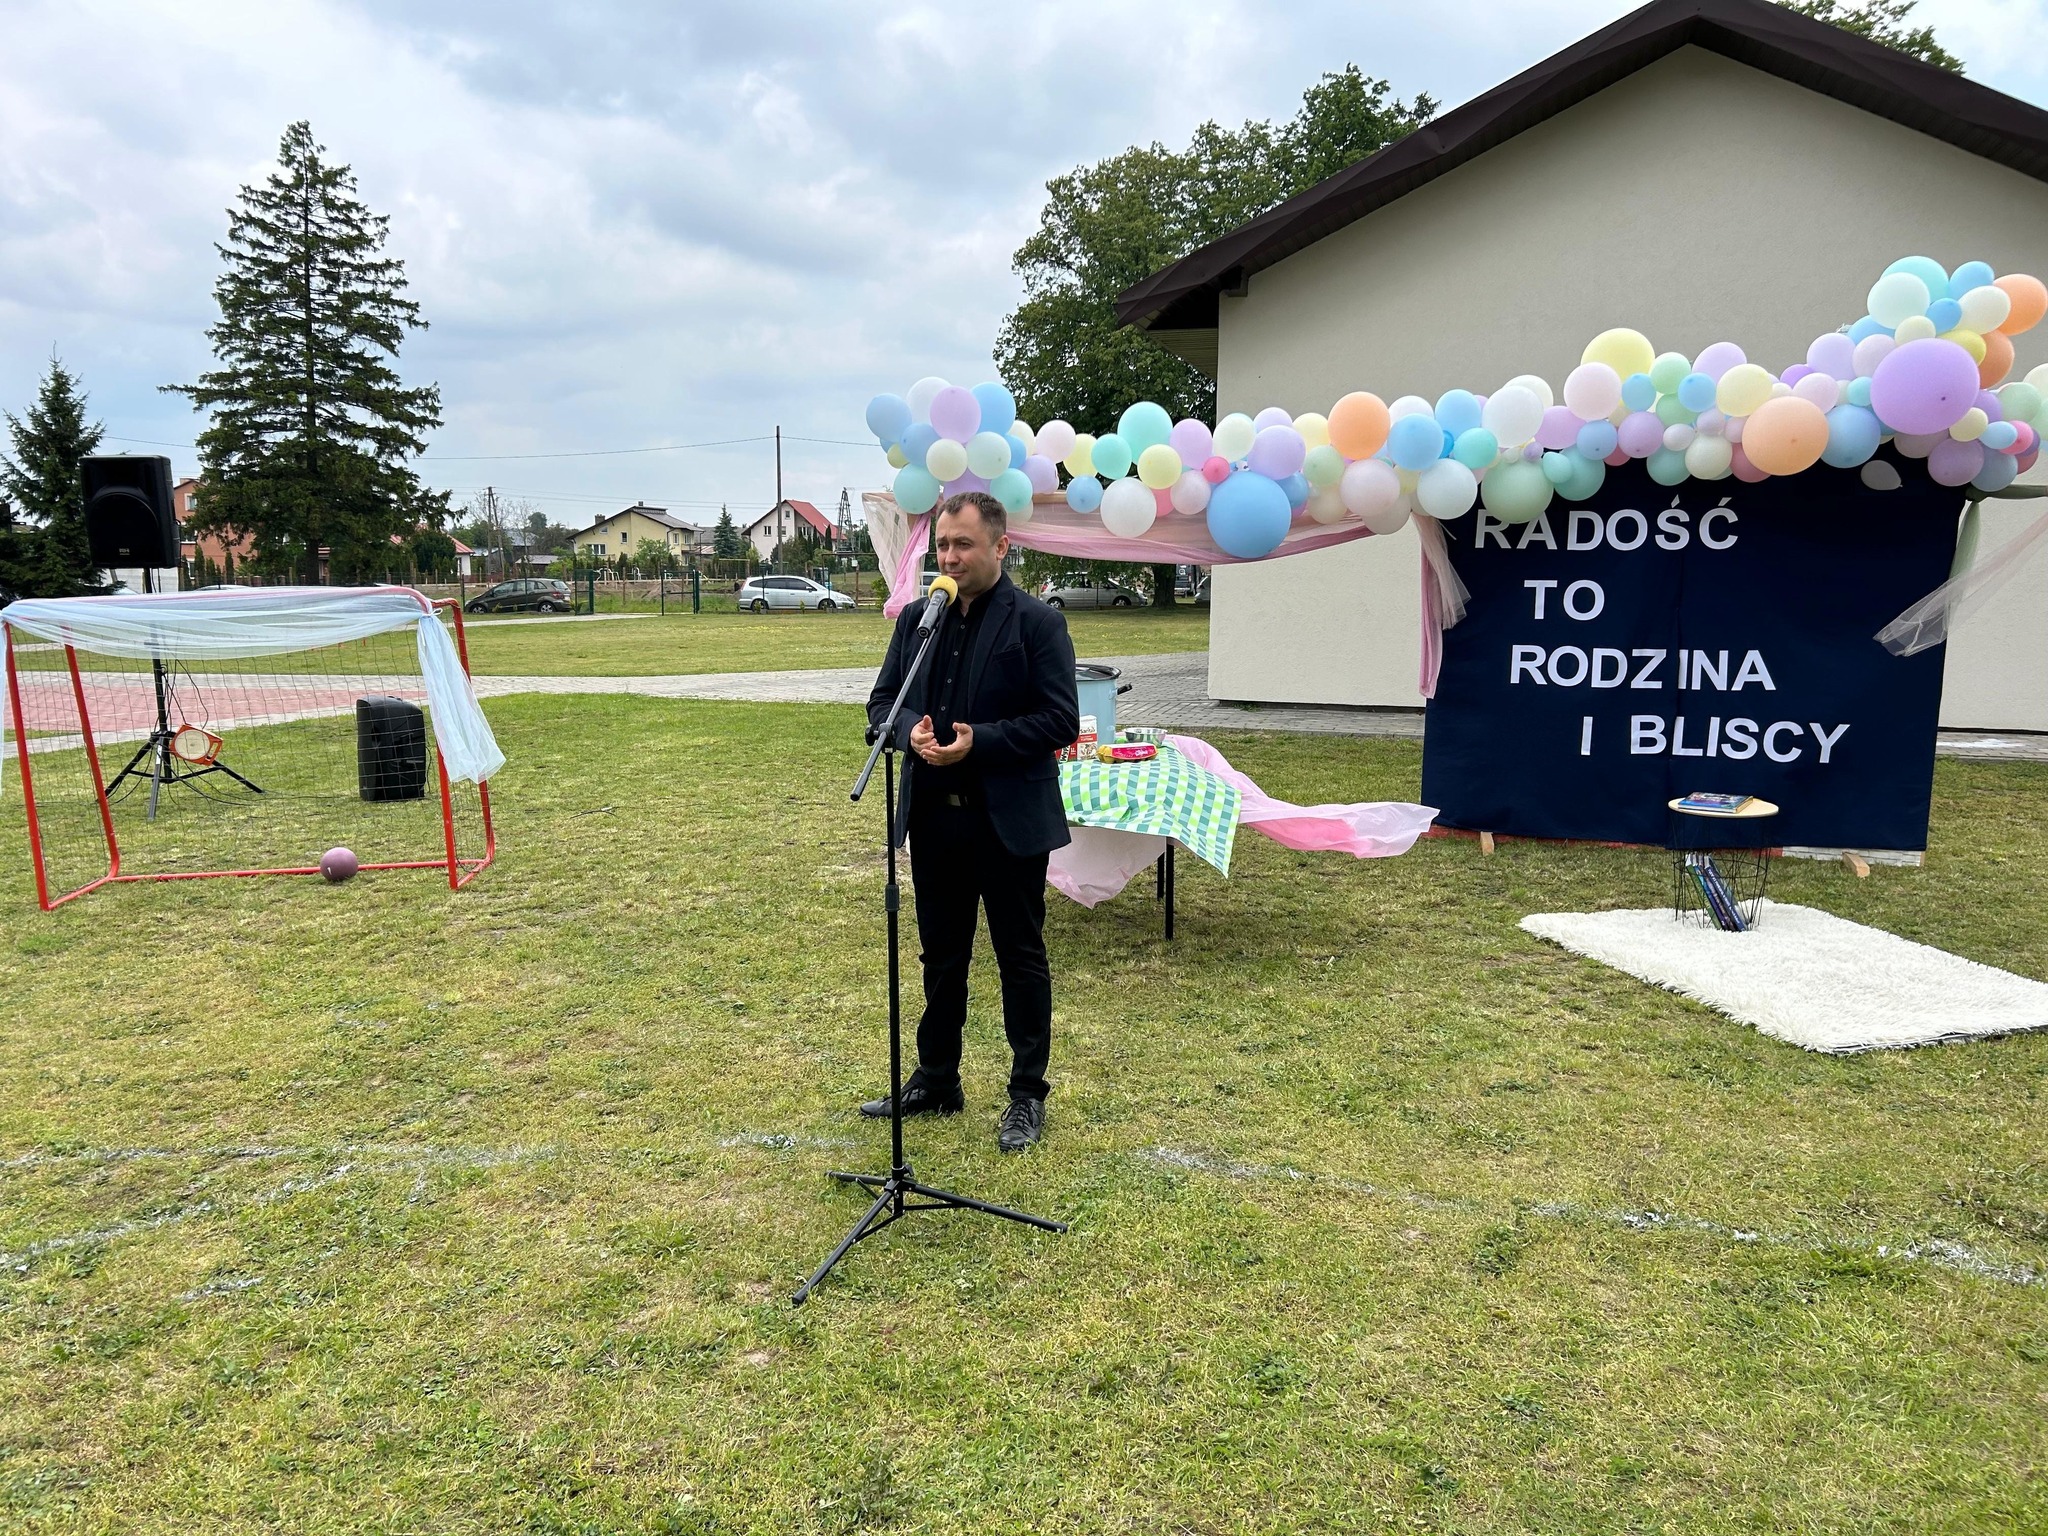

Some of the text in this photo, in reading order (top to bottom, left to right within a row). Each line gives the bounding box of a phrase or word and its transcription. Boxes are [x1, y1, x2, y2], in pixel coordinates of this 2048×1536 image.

[1474, 495, 1739, 551] RADOŚĆ
[1524, 579, 1605, 620] TO
[1510, 644, 1777, 692] RODZINA
[1580, 714, 1851, 764] I BLISCY
